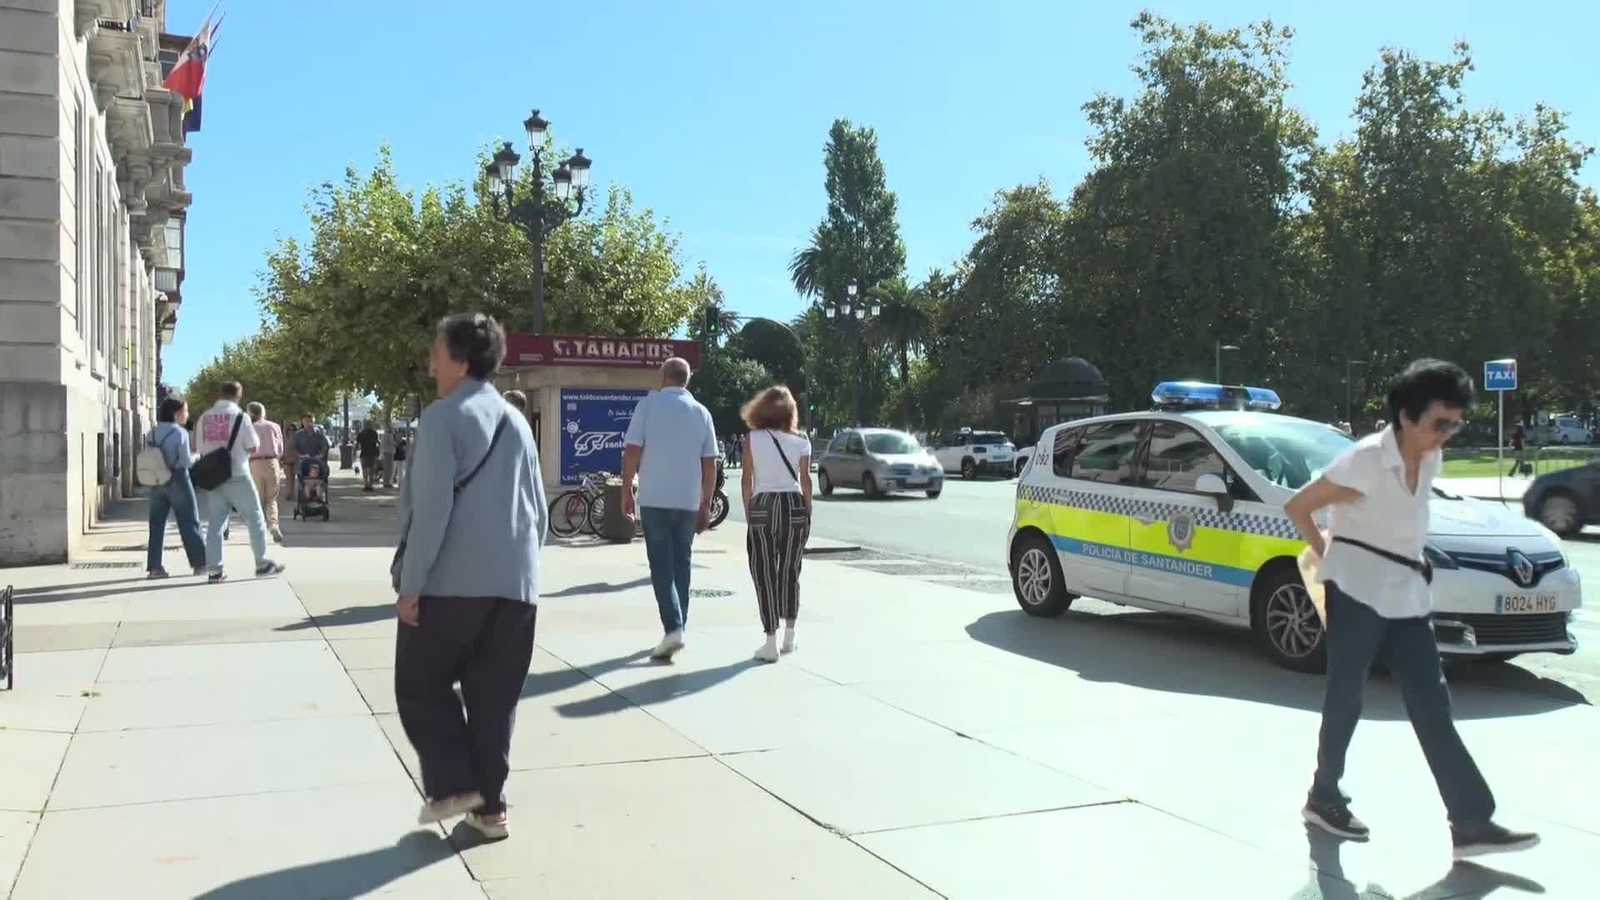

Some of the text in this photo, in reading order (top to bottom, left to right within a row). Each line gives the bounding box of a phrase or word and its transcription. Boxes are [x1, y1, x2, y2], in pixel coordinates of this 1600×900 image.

[573, 340, 674, 359] TABACOS
[1487, 371, 1515, 380] TAXI
[1082, 543, 1213, 577] POLICIA DE SANTANDER
[1505, 594, 1556, 611] 8024 HYG
